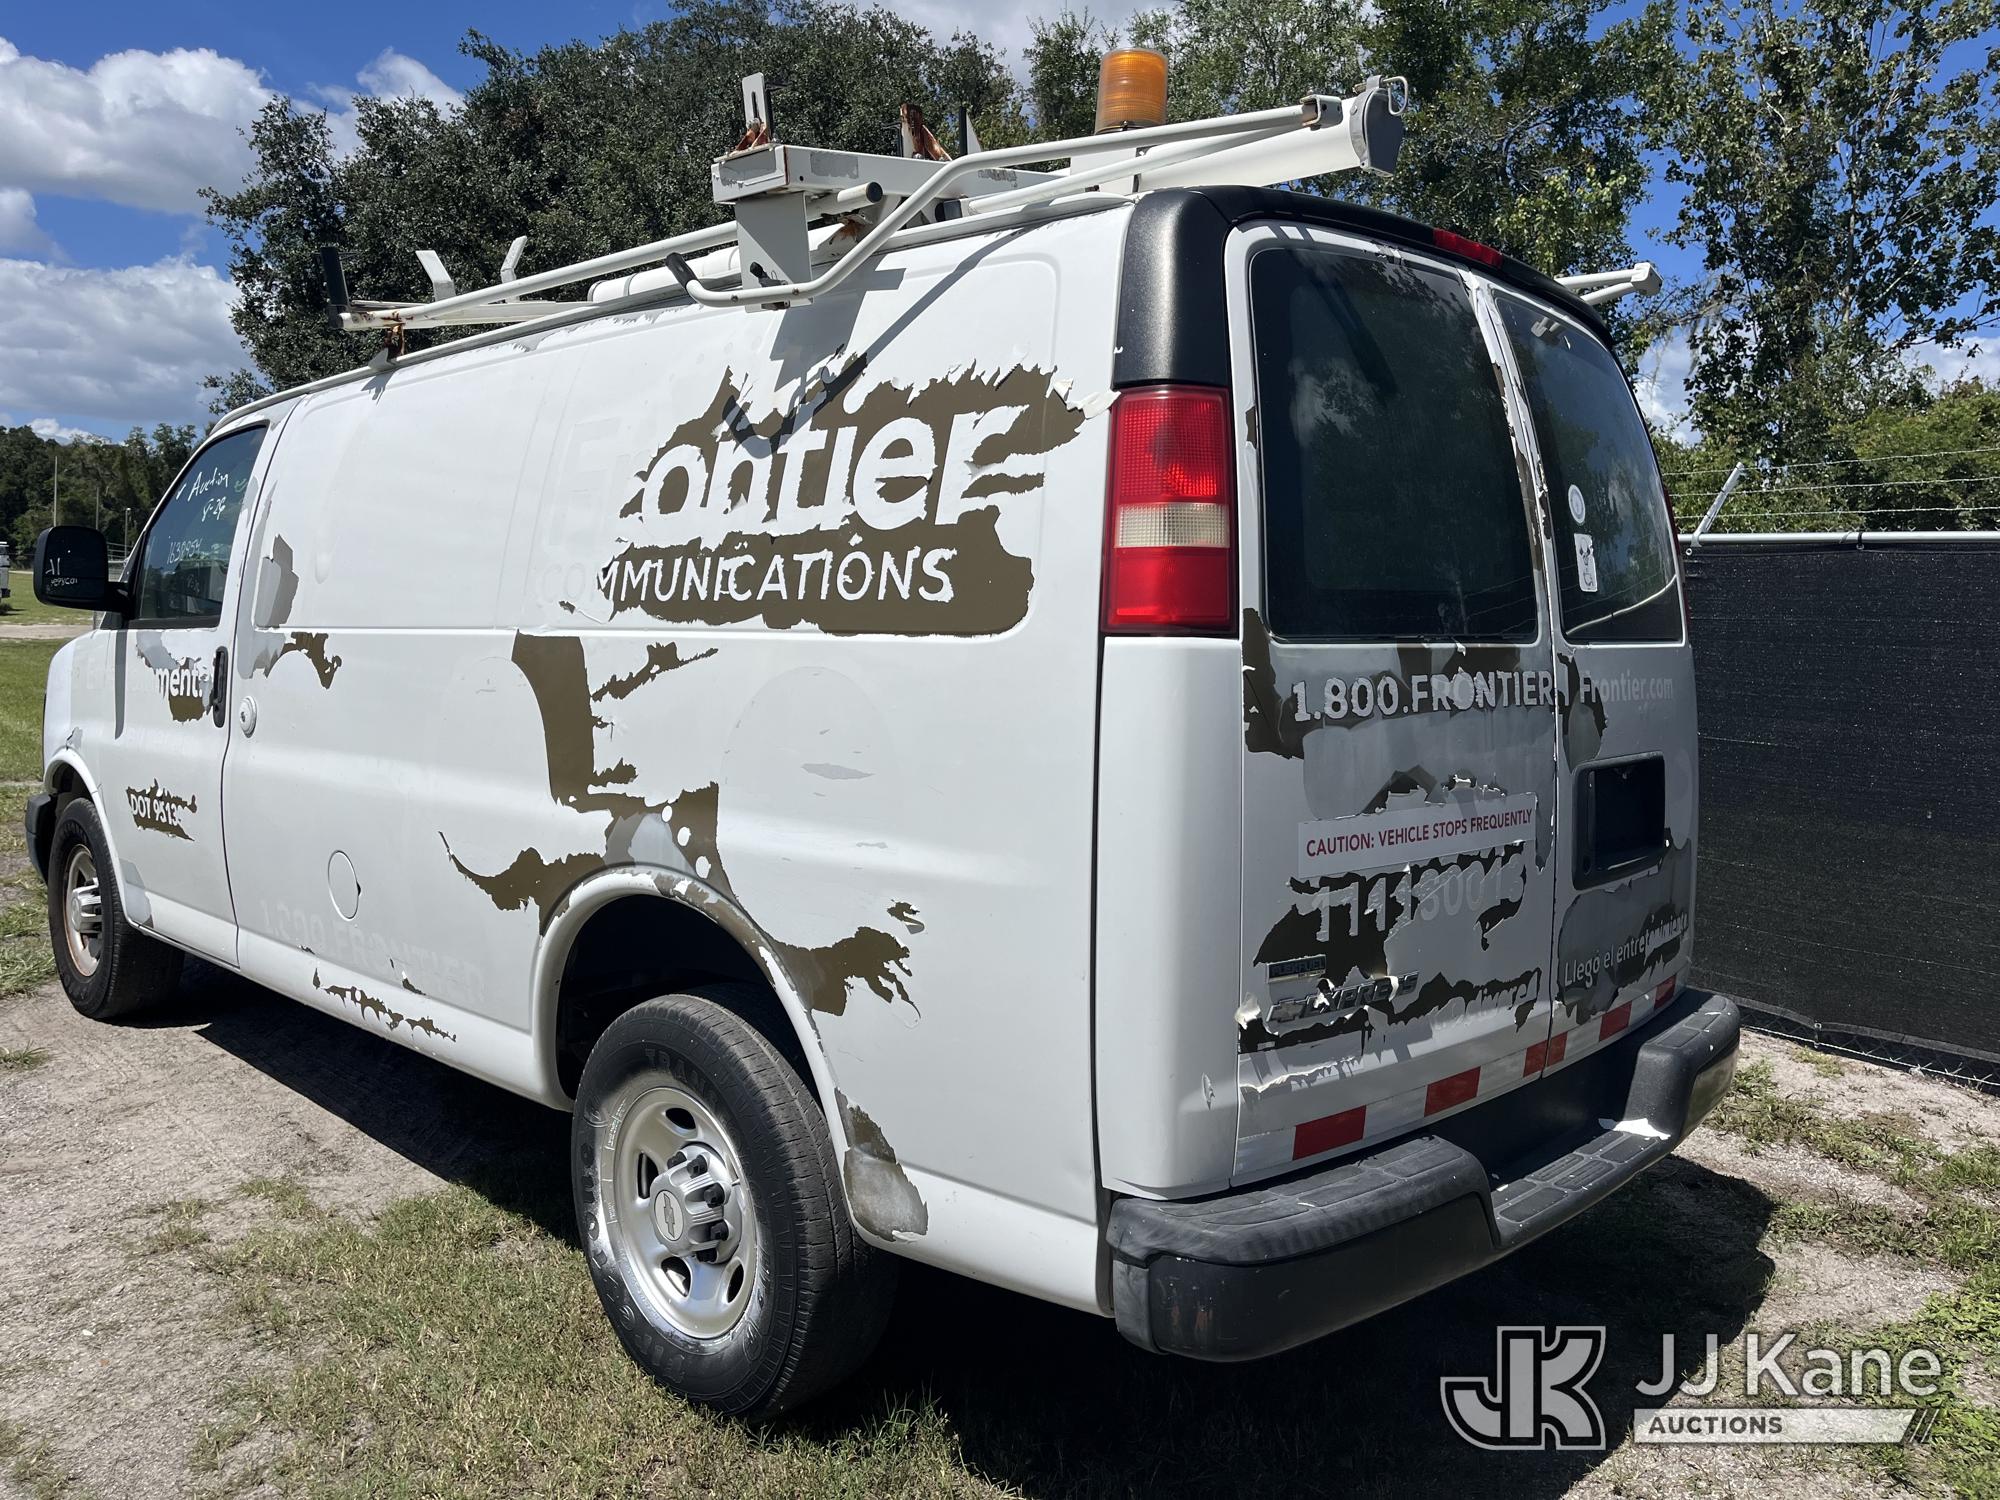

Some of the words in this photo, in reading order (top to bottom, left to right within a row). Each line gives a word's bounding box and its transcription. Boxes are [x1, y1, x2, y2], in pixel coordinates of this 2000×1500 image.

[1580, 668, 1673, 703] Frontier.com
[131, 793, 151, 819] DOT
[1306, 832, 1374, 857] CAUTION:
[1378, 824, 1430, 847] VEHICLE
[1433, 818, 1467, 839] STOPS
[1470, 808, 1533, 833] FREQUENTLY
[1603, 943, 1614, 969] el
